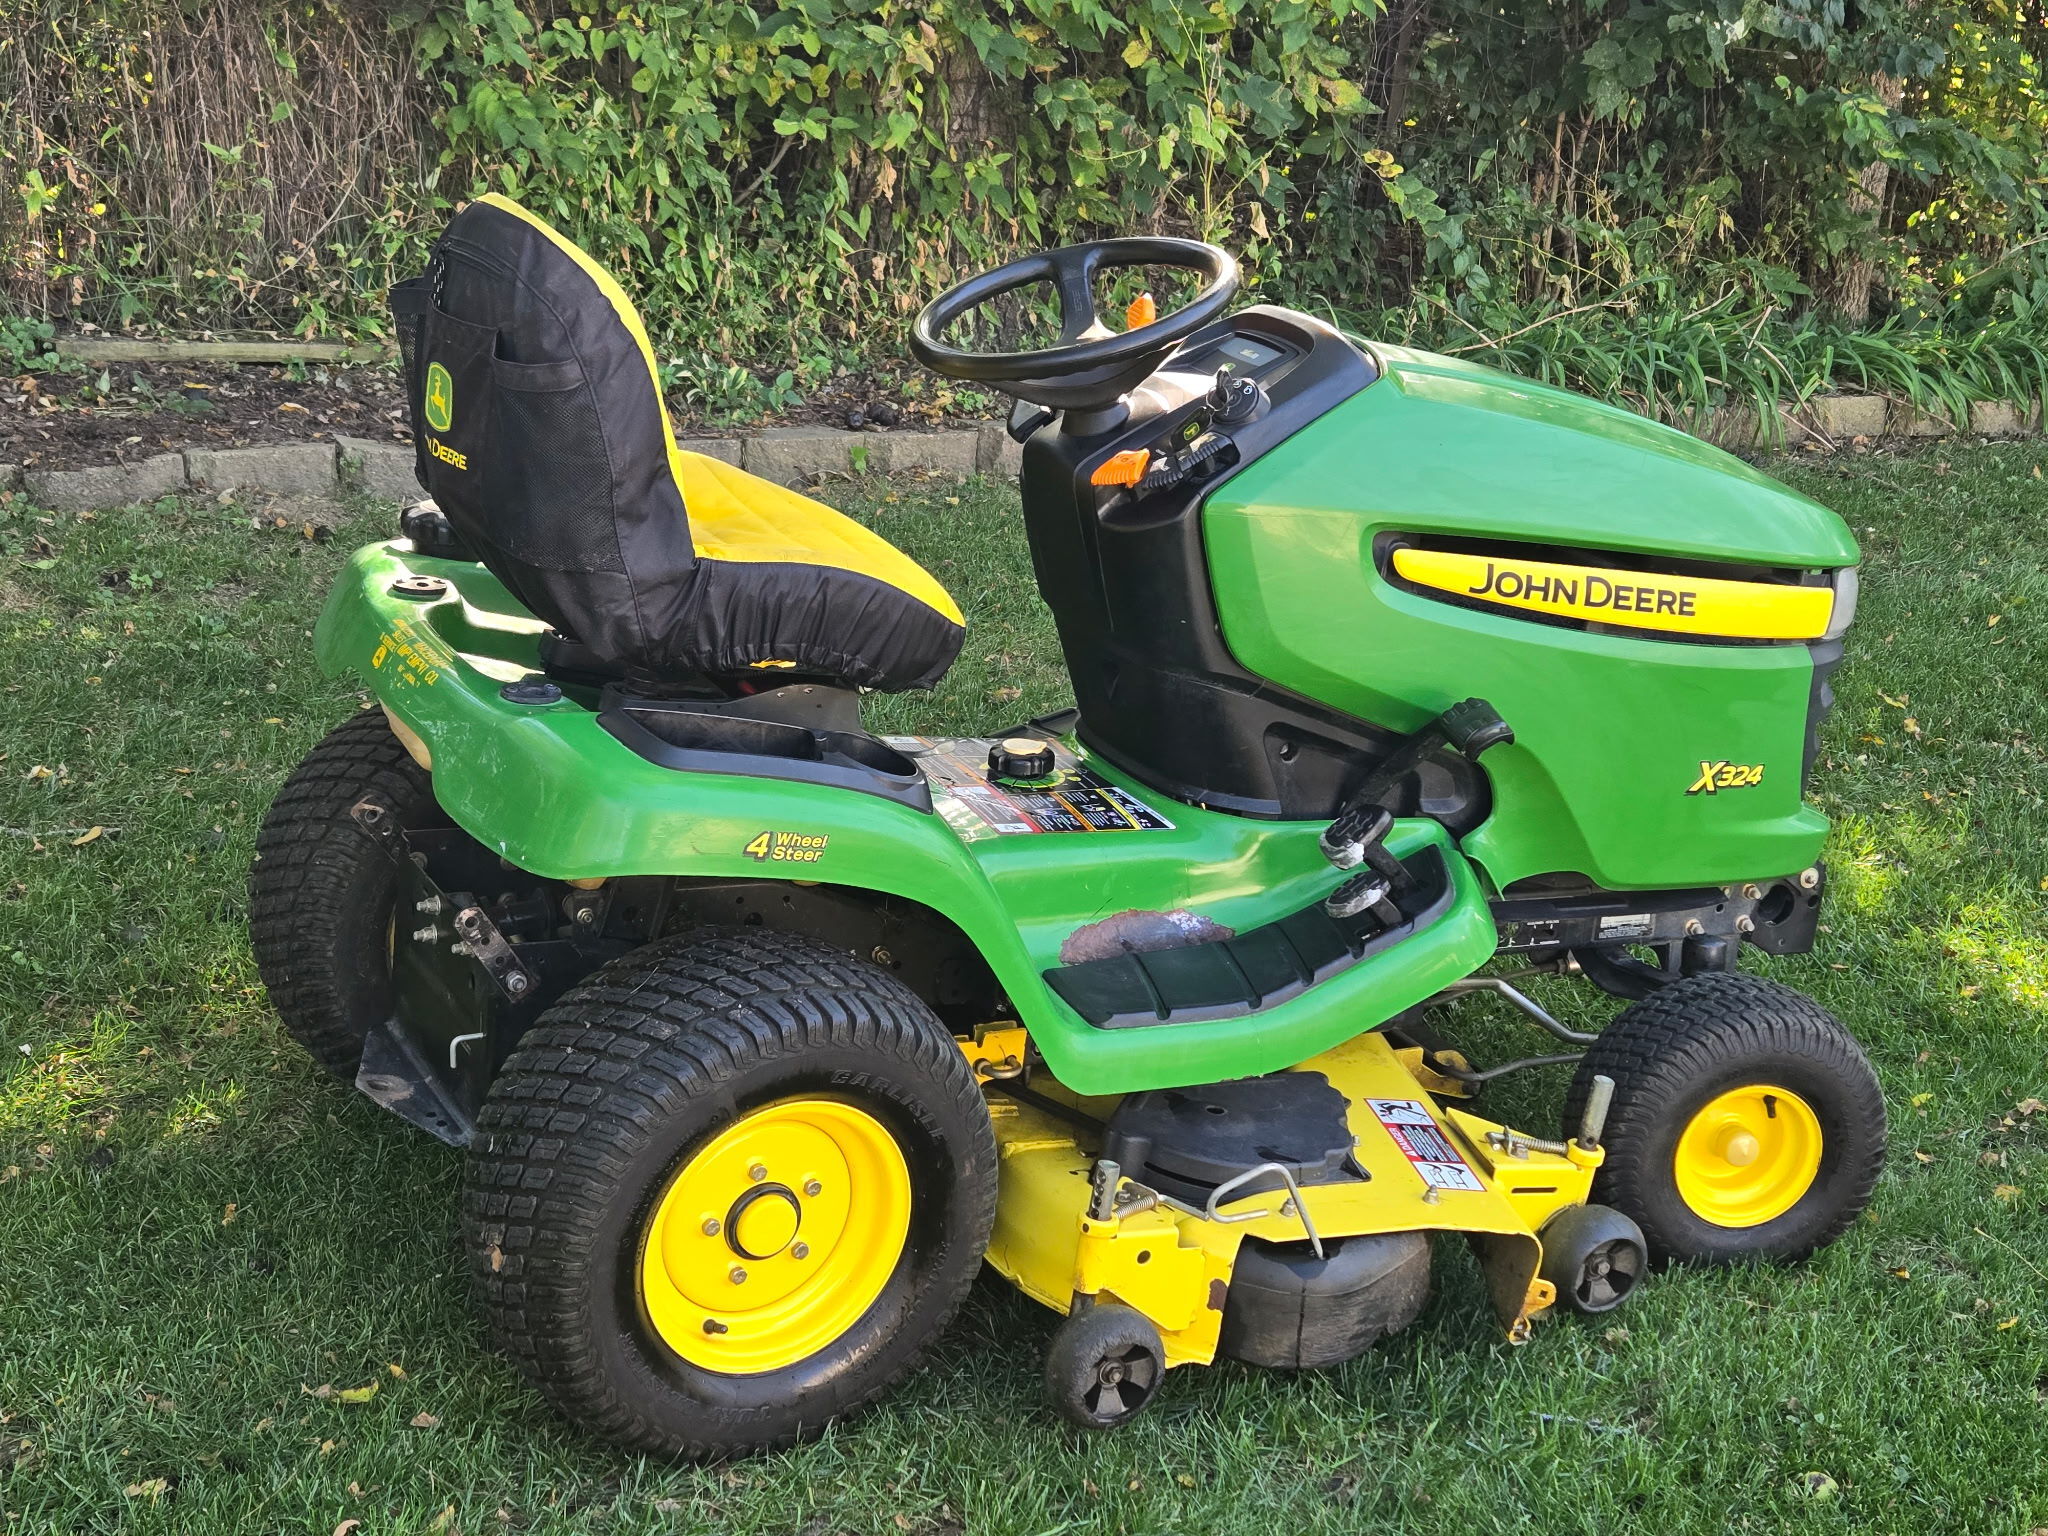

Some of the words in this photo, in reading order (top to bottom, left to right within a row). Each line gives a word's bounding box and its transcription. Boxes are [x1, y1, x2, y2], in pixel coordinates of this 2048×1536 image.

[432, 438, 467, 470] DEERE
[1469, 563, 1578, 605] JOHN
[1584, 575, 1697, 617] DEERE
[1686, 761, 1765, 794] X324
[744, 830, 772, 861] 4
[776, 831, 829, 849] Wheel
[771, 846, 824, 862] Steer
[831, 1069, 947, 1145] CARLISLE
